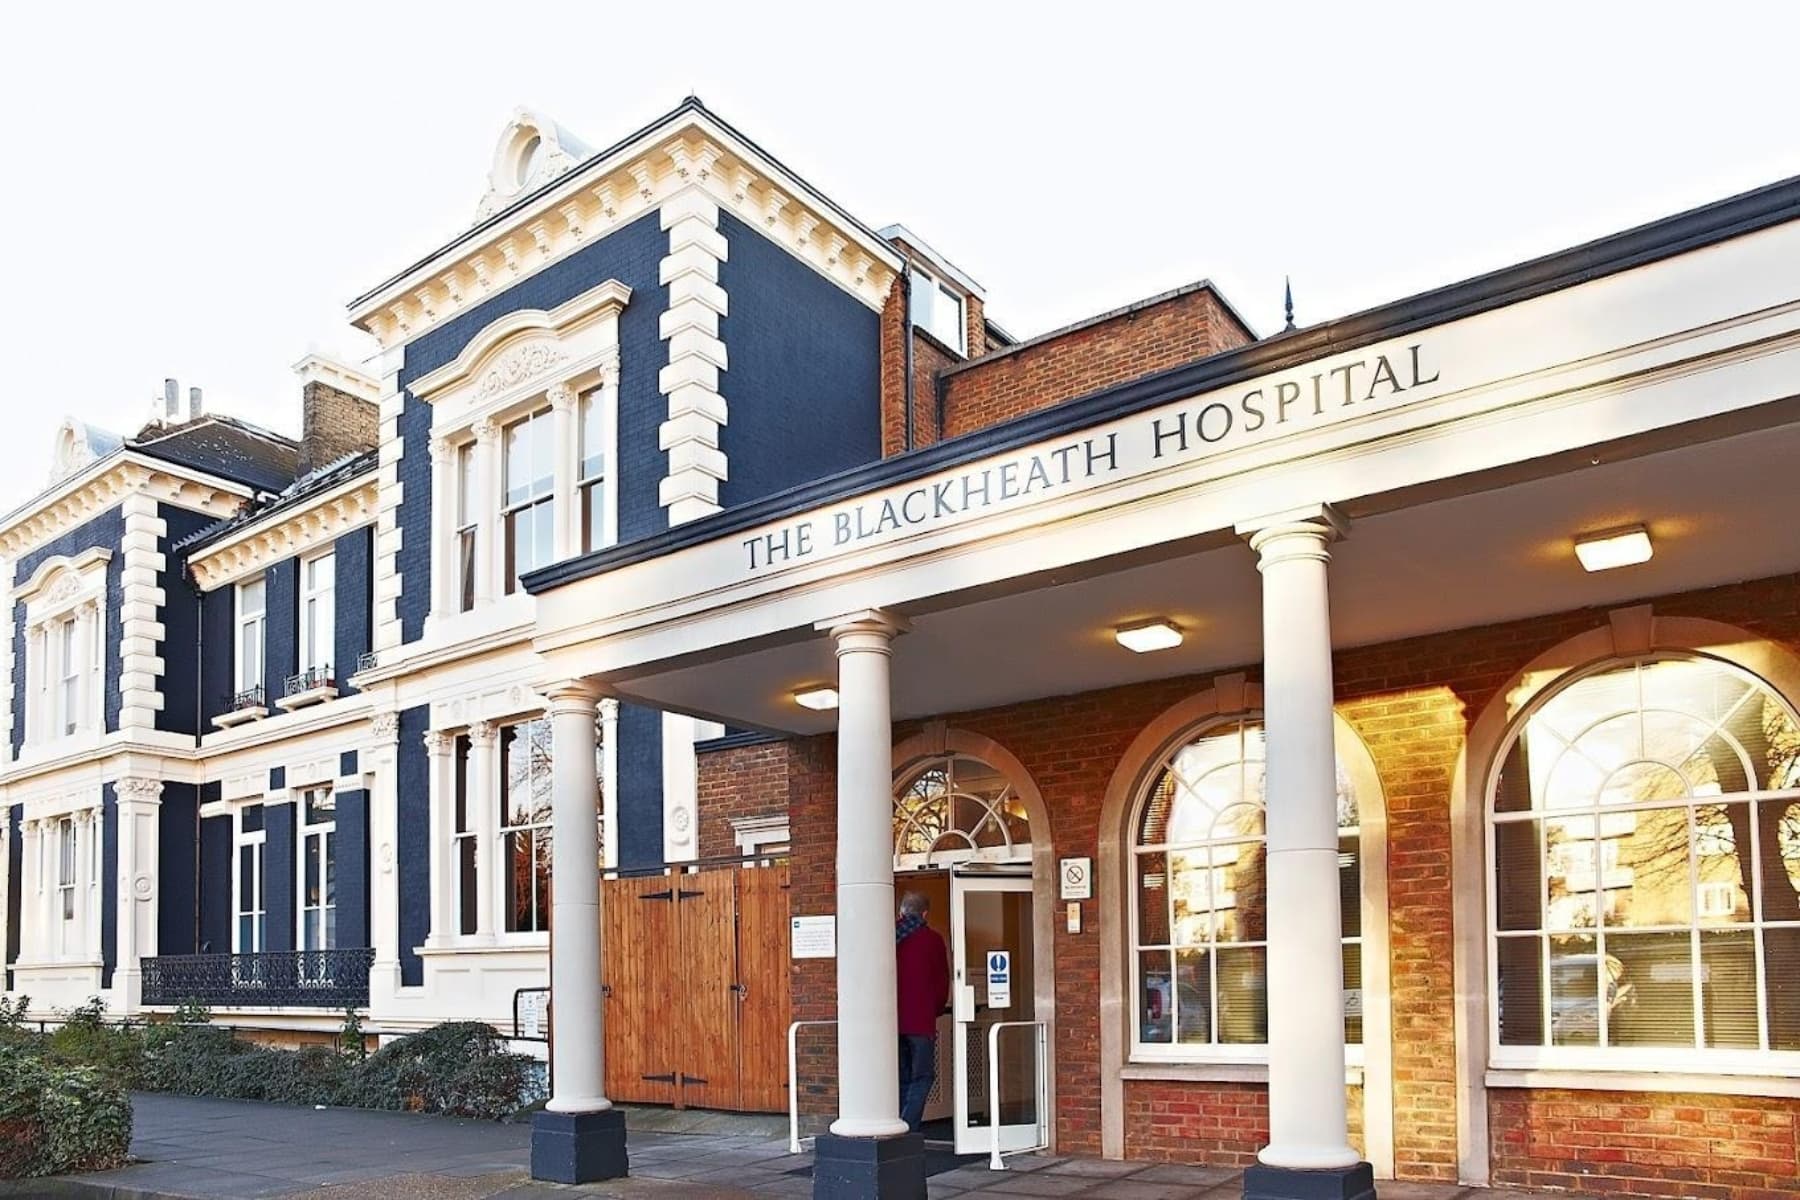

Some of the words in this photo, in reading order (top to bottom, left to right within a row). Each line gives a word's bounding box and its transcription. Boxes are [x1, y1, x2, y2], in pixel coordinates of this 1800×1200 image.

[743, 519, 813, 570] THE
[832, 432, 1119, 547] BLACKHEATH
[1153, 344, 1441, 459] HOSPITAL
